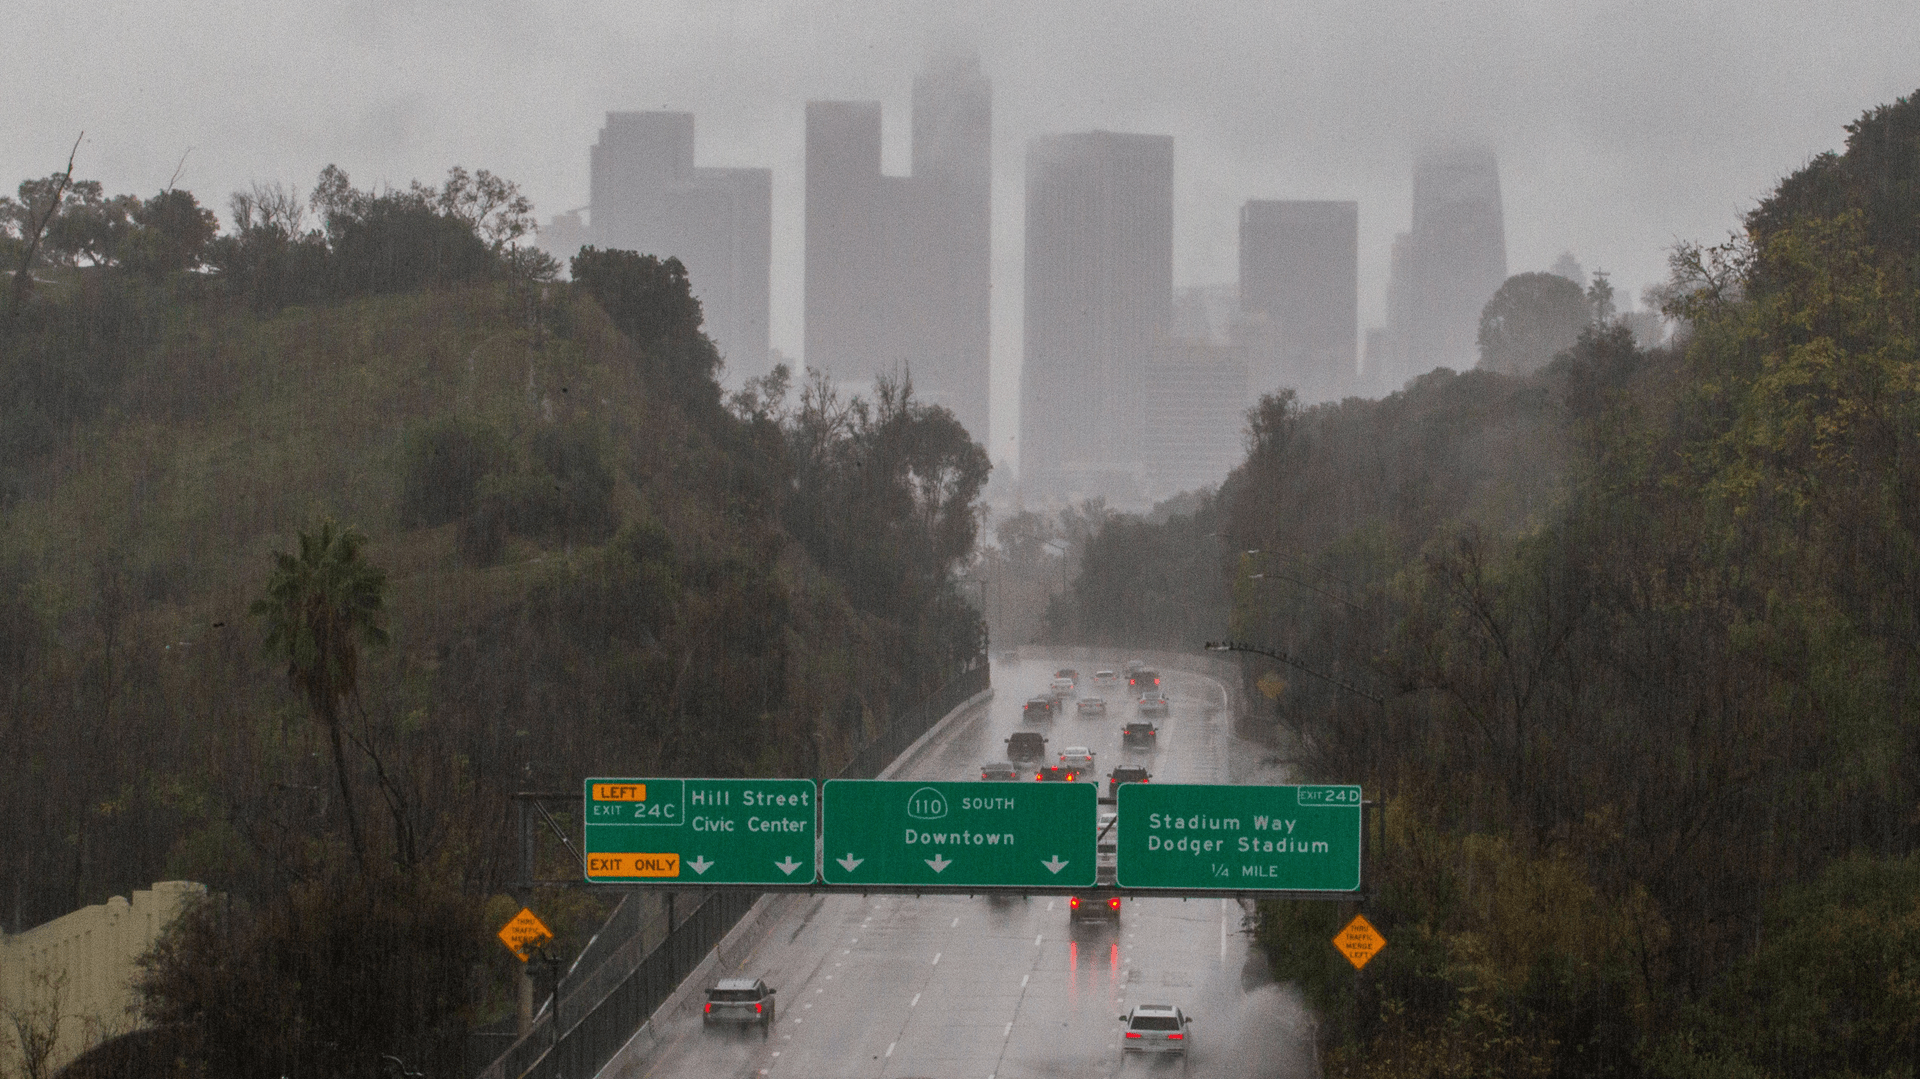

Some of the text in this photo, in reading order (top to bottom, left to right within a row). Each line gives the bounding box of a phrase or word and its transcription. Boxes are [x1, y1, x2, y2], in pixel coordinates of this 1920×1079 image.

[601, 786, 637, 799] LEFT
[691, 790, 809, 807] Hill Street
[1300, 790, 1359, 802] EXIT 24D
[593, 803, 675, 818] EXIT 24C
[915, 797, 1015, 814] 110 SOUTH
[692, 816, 808, 833] Civic Center
[1149, 813, 1296, 834] Stadium Way
[905, 829, 1015, 845] Downtown
[1148, 835, 1329, 856] Dodger Stadium
[590, 859, 676, 871] EXIT ONLY
[1242, 865, 1278, 878] MILE
